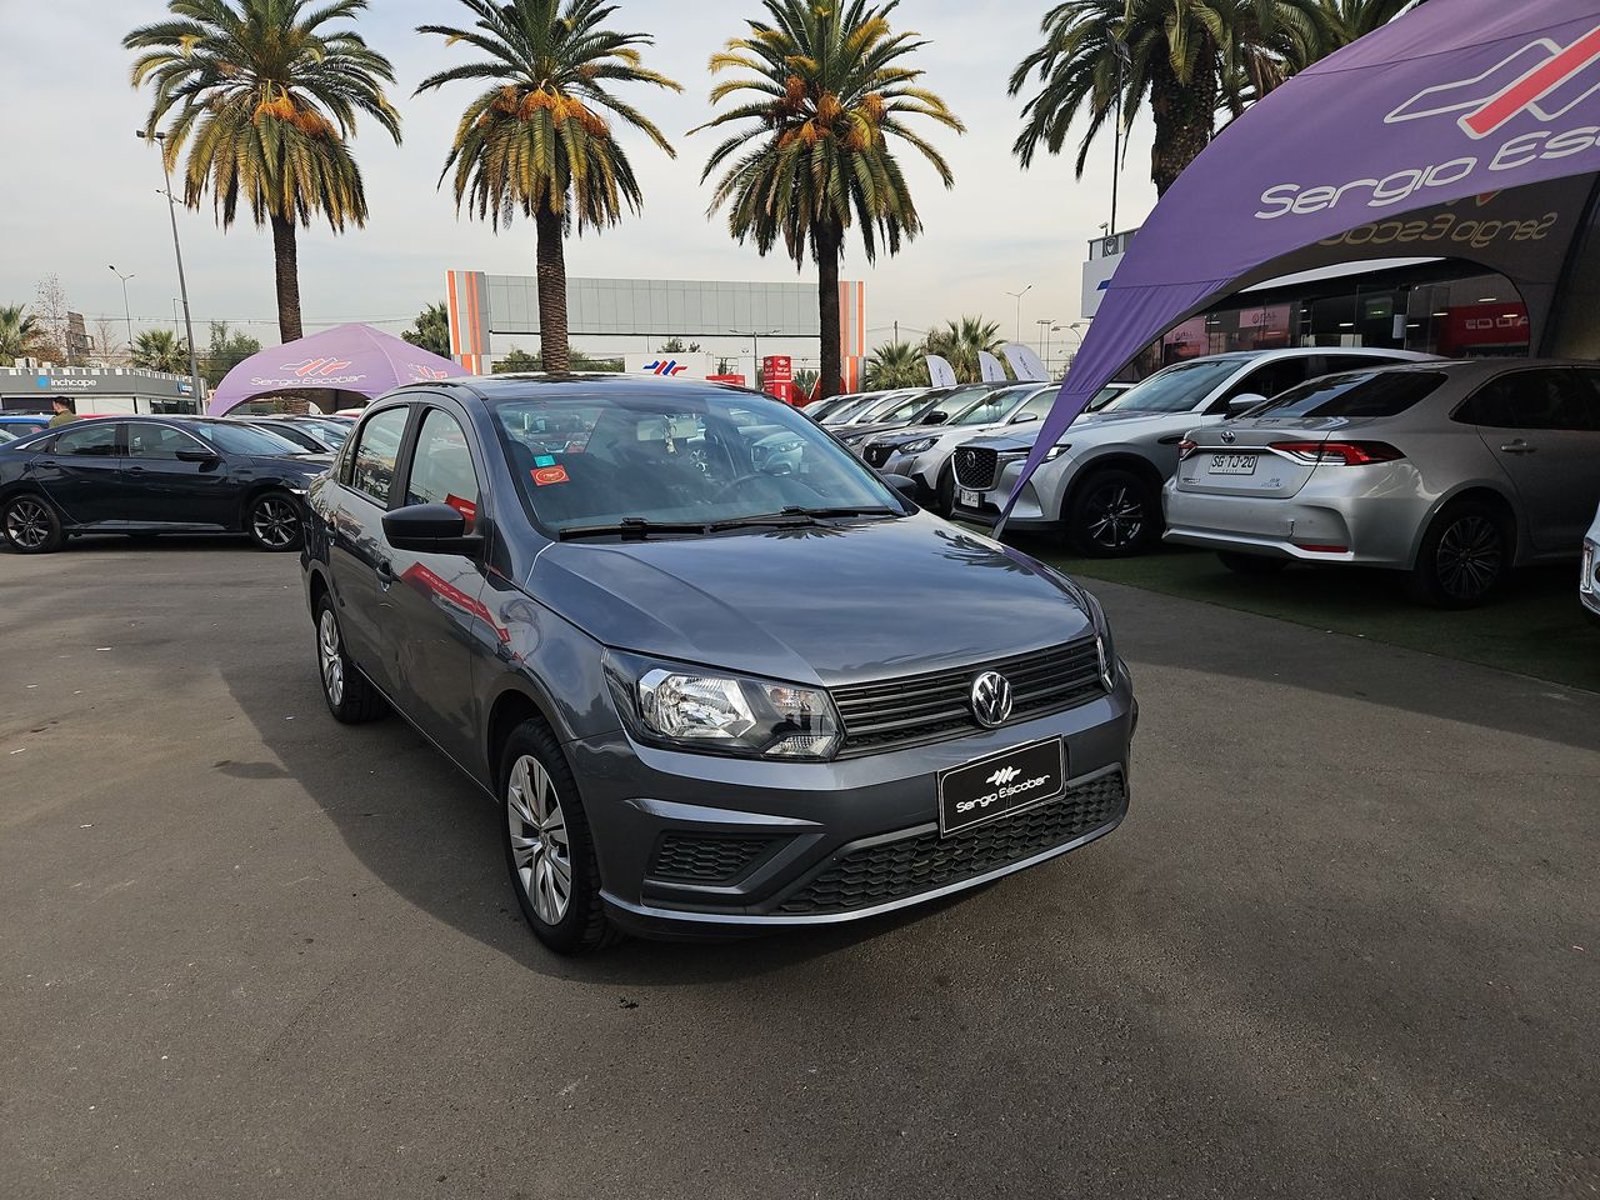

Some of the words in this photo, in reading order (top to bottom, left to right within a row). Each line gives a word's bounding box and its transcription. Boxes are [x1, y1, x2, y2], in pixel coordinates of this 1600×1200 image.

[1254, 156, 1478, 219] Sergio
[1488, 126, 1600, 171] Es
[50, 378, 97, 388] inchcape
[250, 377, 300, 386] Sergio
[302, 375, 367, 385] Escobar
[955, 793, 998, 813] Sergio
[998, 775, 1051, 798] Escobar
